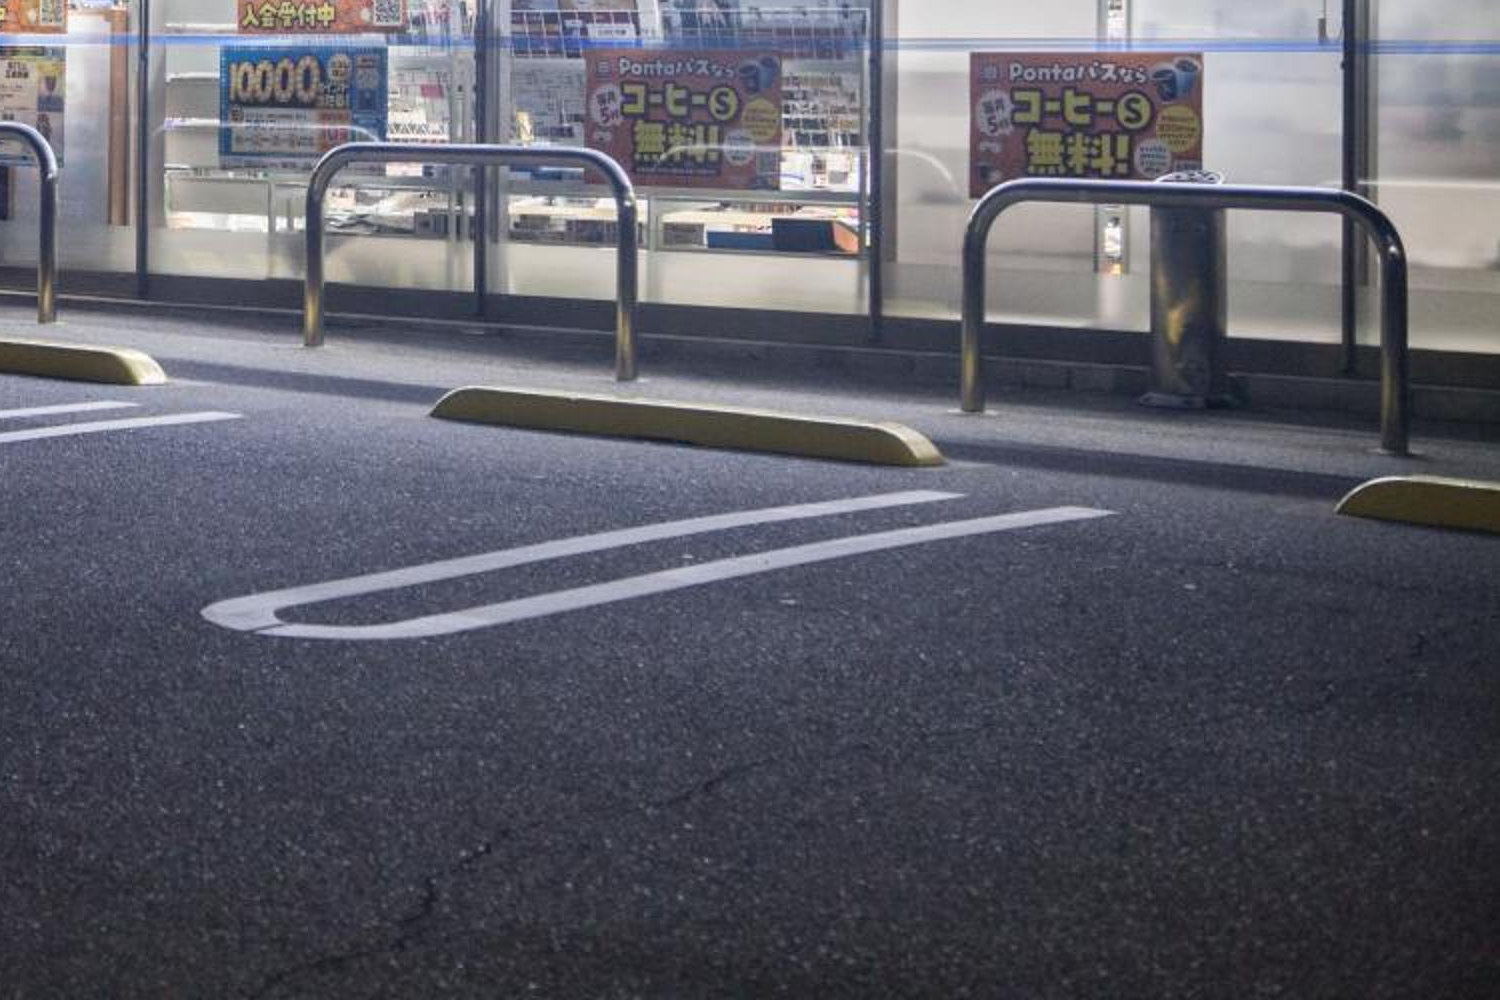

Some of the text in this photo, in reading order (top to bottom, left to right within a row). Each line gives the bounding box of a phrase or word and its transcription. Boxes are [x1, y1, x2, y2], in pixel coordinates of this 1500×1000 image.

[242, 1, 335, 28] 入会受付中
[618, 57, 735, 78] Pontaパスなら
[1008, 61, 1148, 83] Pontaパスなら
[634, 119, 720, 163] 無料!
[1026, 127, 1131, 175] 無料!
